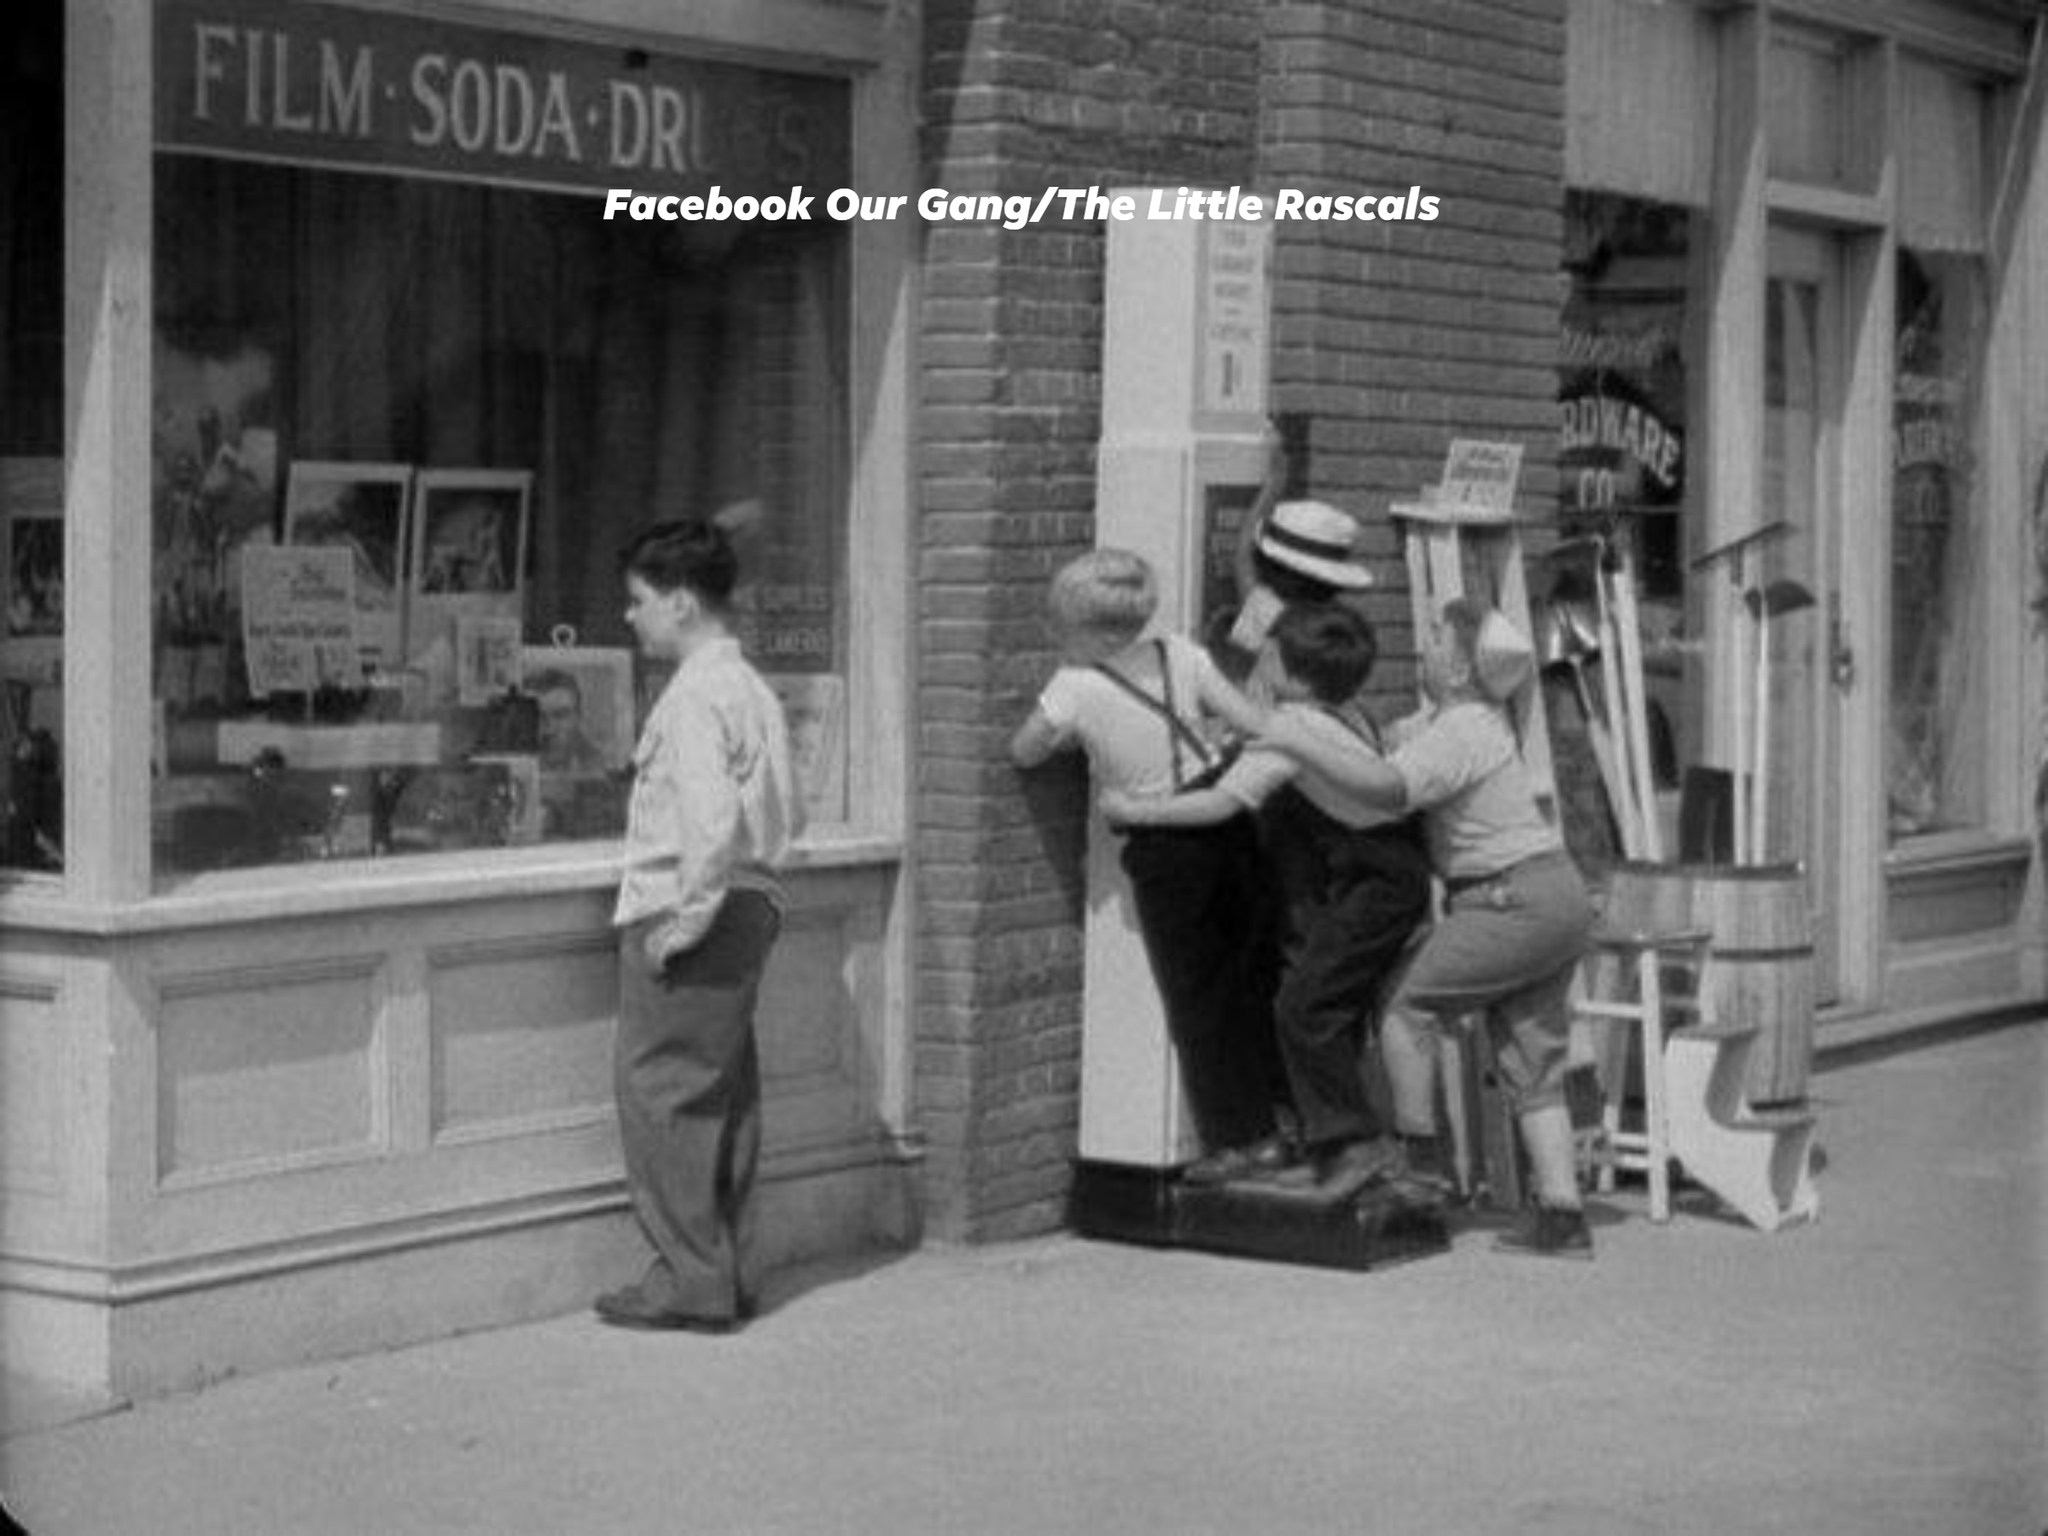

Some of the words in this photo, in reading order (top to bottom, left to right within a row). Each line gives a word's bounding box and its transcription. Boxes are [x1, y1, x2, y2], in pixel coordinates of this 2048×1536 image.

[193, 24, 372, 138] FILM
[411, 54, 582, 161] SODA
[1560, 396, 1682, 487] RDWARE
